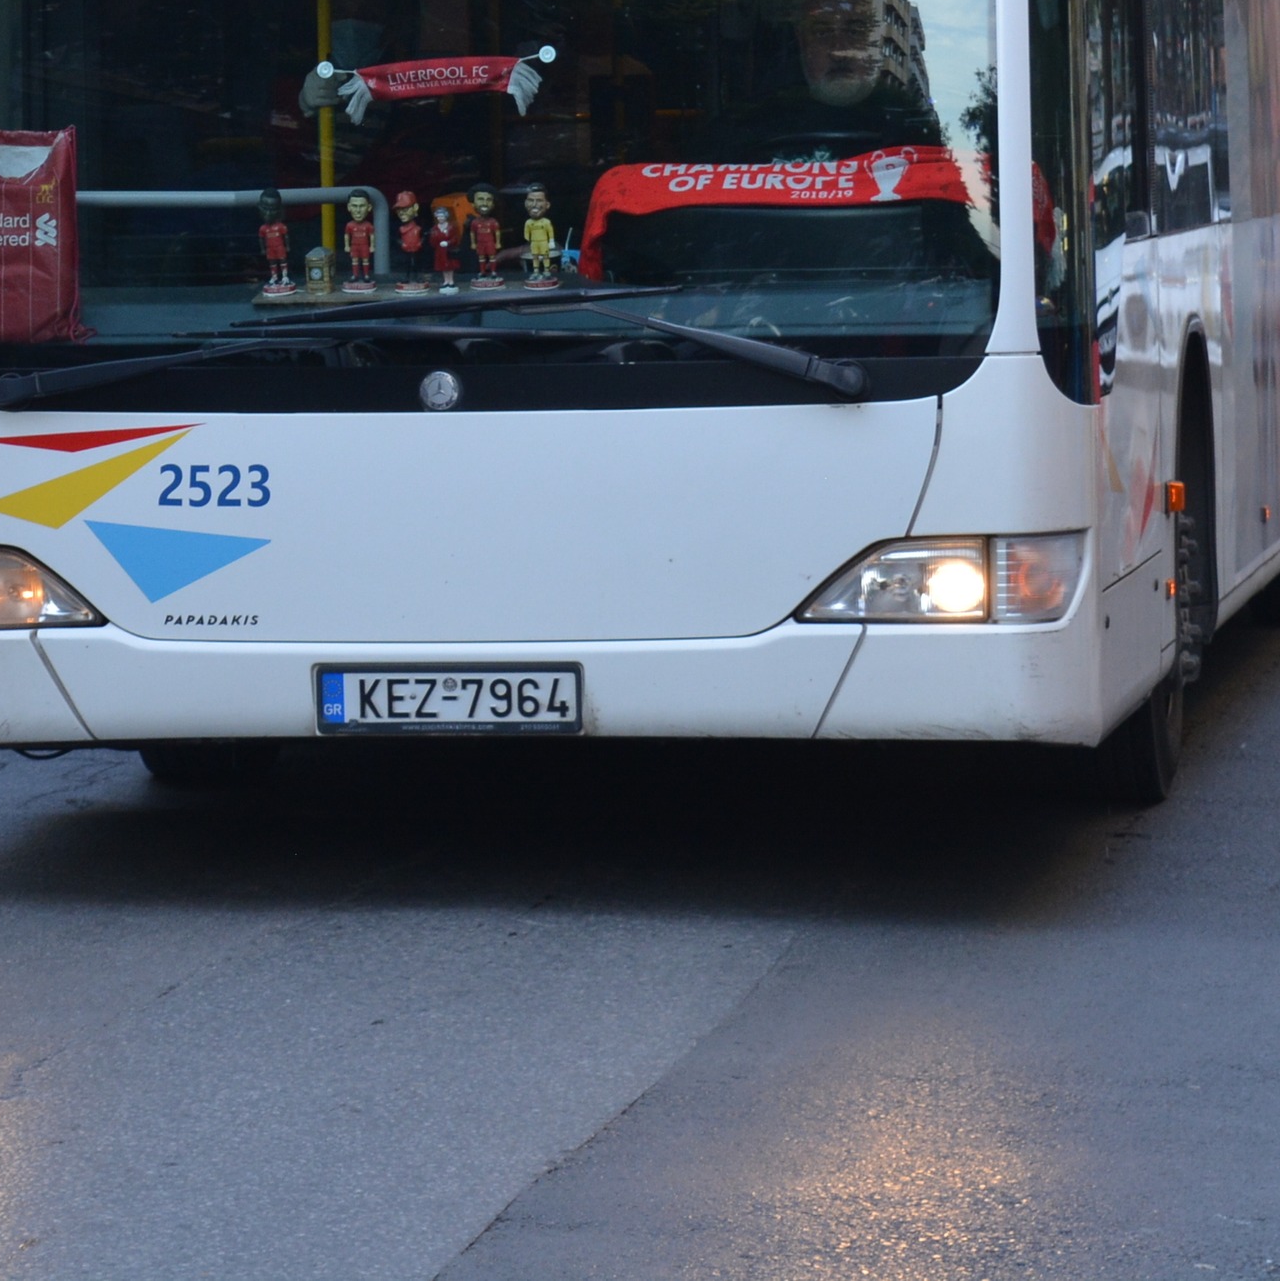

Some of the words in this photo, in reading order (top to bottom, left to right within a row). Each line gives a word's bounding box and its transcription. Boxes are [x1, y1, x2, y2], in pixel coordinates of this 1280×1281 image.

[387, 65, 467, 86] LIVERPOOL
[472, 65, 489, 79] FC
[668, 174, 715, 192] OF
[790, 189, 854, 199] 2018/19
[158, 463, 271, 507] 2523
[164, 614, 260, 626] PAPADAKIS
[323, 703, 343, 716] GR
[358, 677, 570, 719] KEZ-7964
